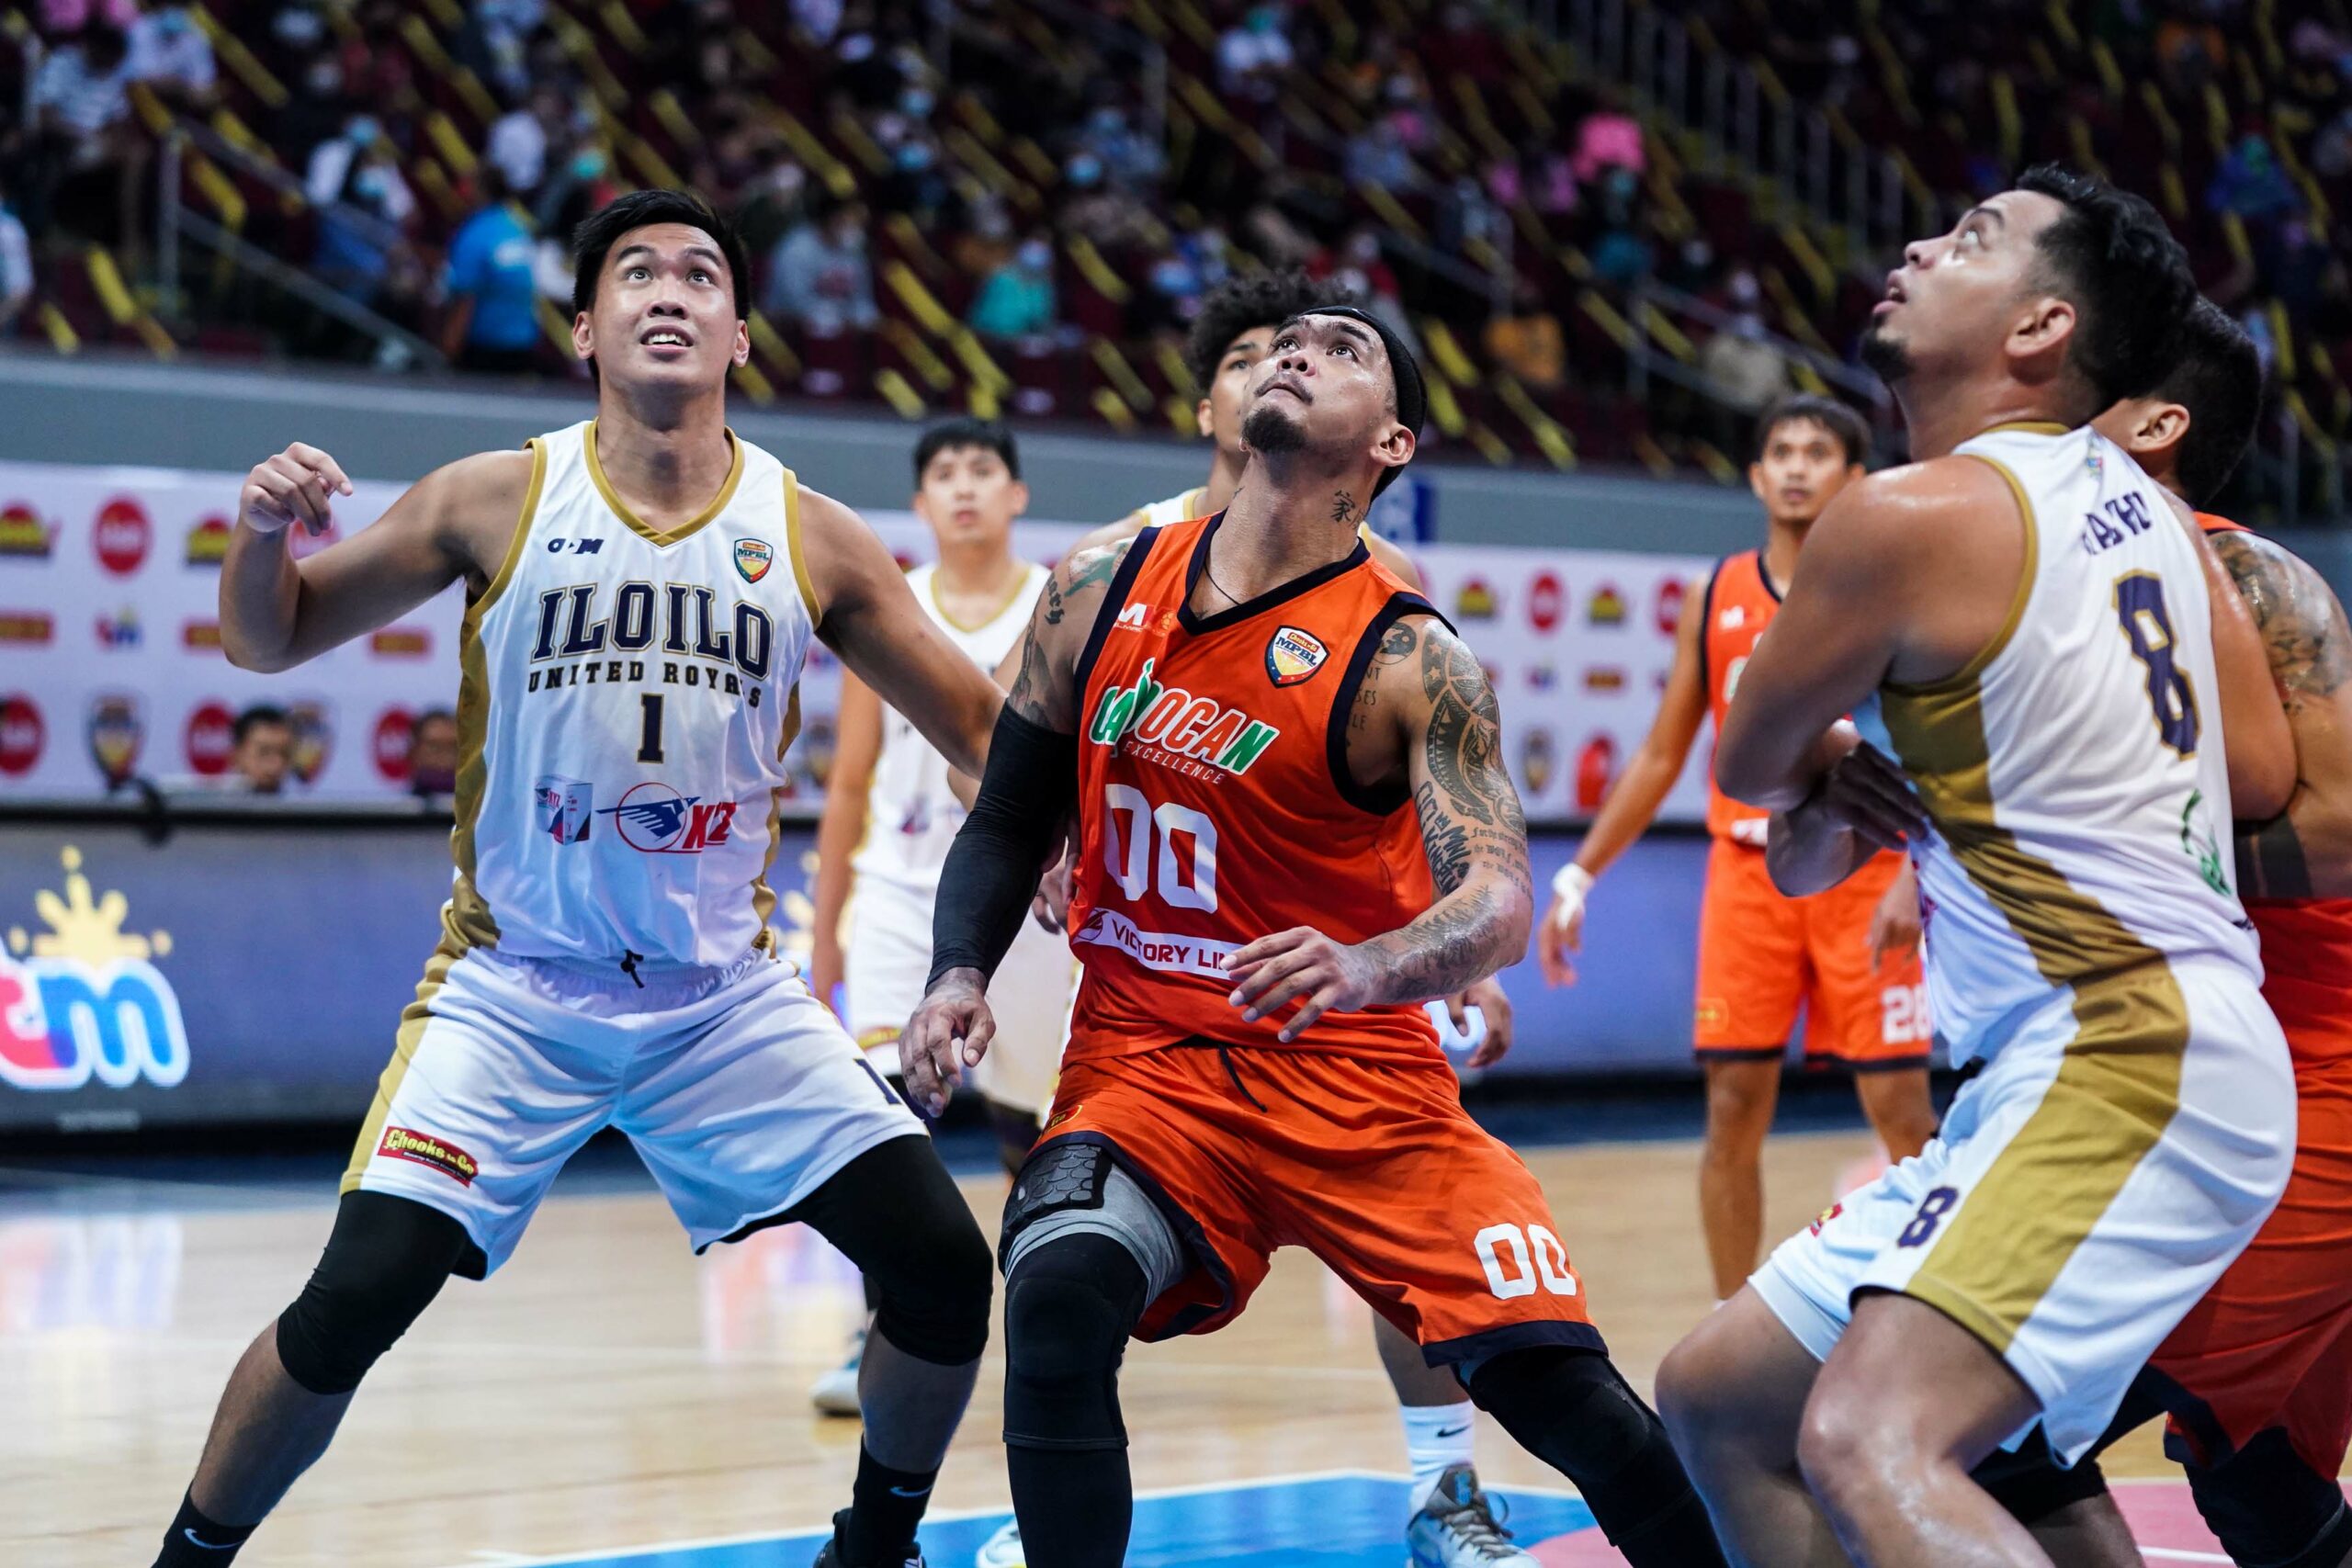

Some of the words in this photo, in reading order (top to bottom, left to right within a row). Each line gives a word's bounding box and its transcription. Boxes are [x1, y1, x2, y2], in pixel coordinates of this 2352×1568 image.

[530, 581, 775, 682] ILOILO
[1275, 637, 1317, 666] MPBL
[528, 660, 644, 694] UNITED
[663, 662, 762, 708] ROYAS
[2111, 570, 2200, 761] 8
[637, 693, 665, 764] 1
[1123, 741, 1226, 785] EXCELLENCE
[1104, 784, 1218, 914] 00
[1112, 919, 1191, 964] VICTORY
[386, 1129, 446, 1158] Chooks
[1897, 1186, 1959, 1249] 8
[1474, 1223, 1577, 1301] 00
